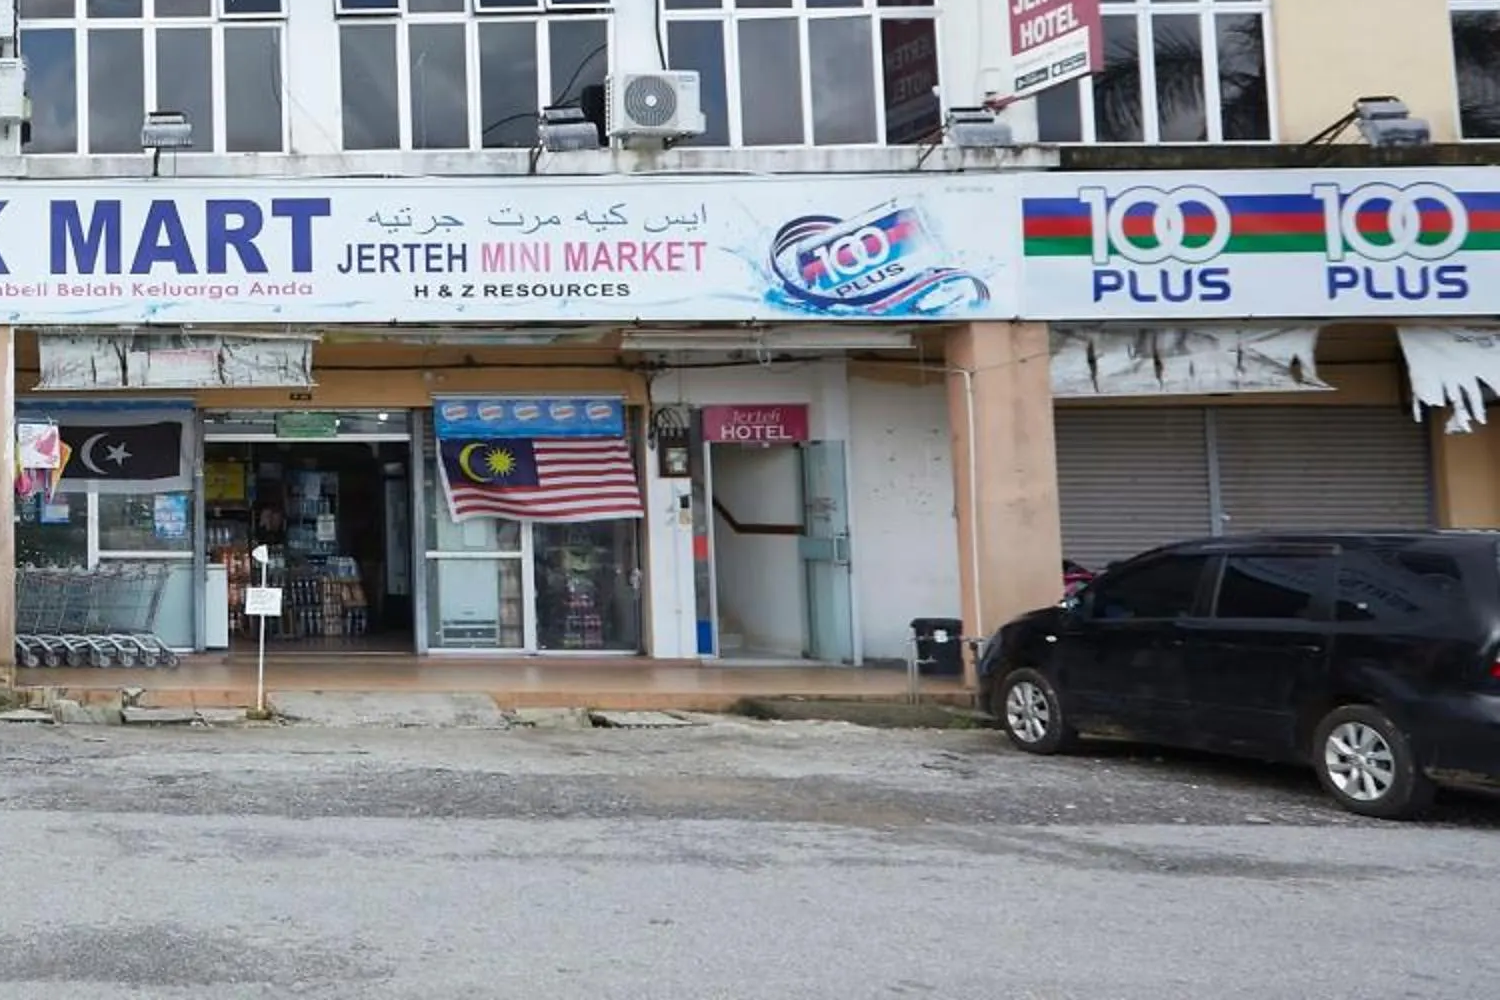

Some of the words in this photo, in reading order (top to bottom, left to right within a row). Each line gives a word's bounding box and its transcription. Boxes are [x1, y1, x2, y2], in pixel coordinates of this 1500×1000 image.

[1019, 2, 1079, 48] HOTEL
[50, 198, 331, 275] MART
[1078, 185, 1231, 265] 100
[1311, 181, 1469, 262] 100
[337, 243, 468, 274] JERTEH
[481, 242, 551, 273] MINI
[564, 241, 707, 272] MARKET
[814, 226, 889, 284] 100
[57, 282, 123, 297] Belah
[132, 281, 240, 300] Keluarga
[249, 280, 314, 296] Anda
[414, 286, 429, 298] H
[439, 286, 453, 298] &
[462, 286, 475, 298] Z
[484, 284, 631, 298] RESOURCES
[835, 262, 905, 297] PLUS
[1093, 267, 1232, 303] PLUS
[1328, 265, 1470, 299] PLUS
[720, 424, 793, 440] HOTEL
